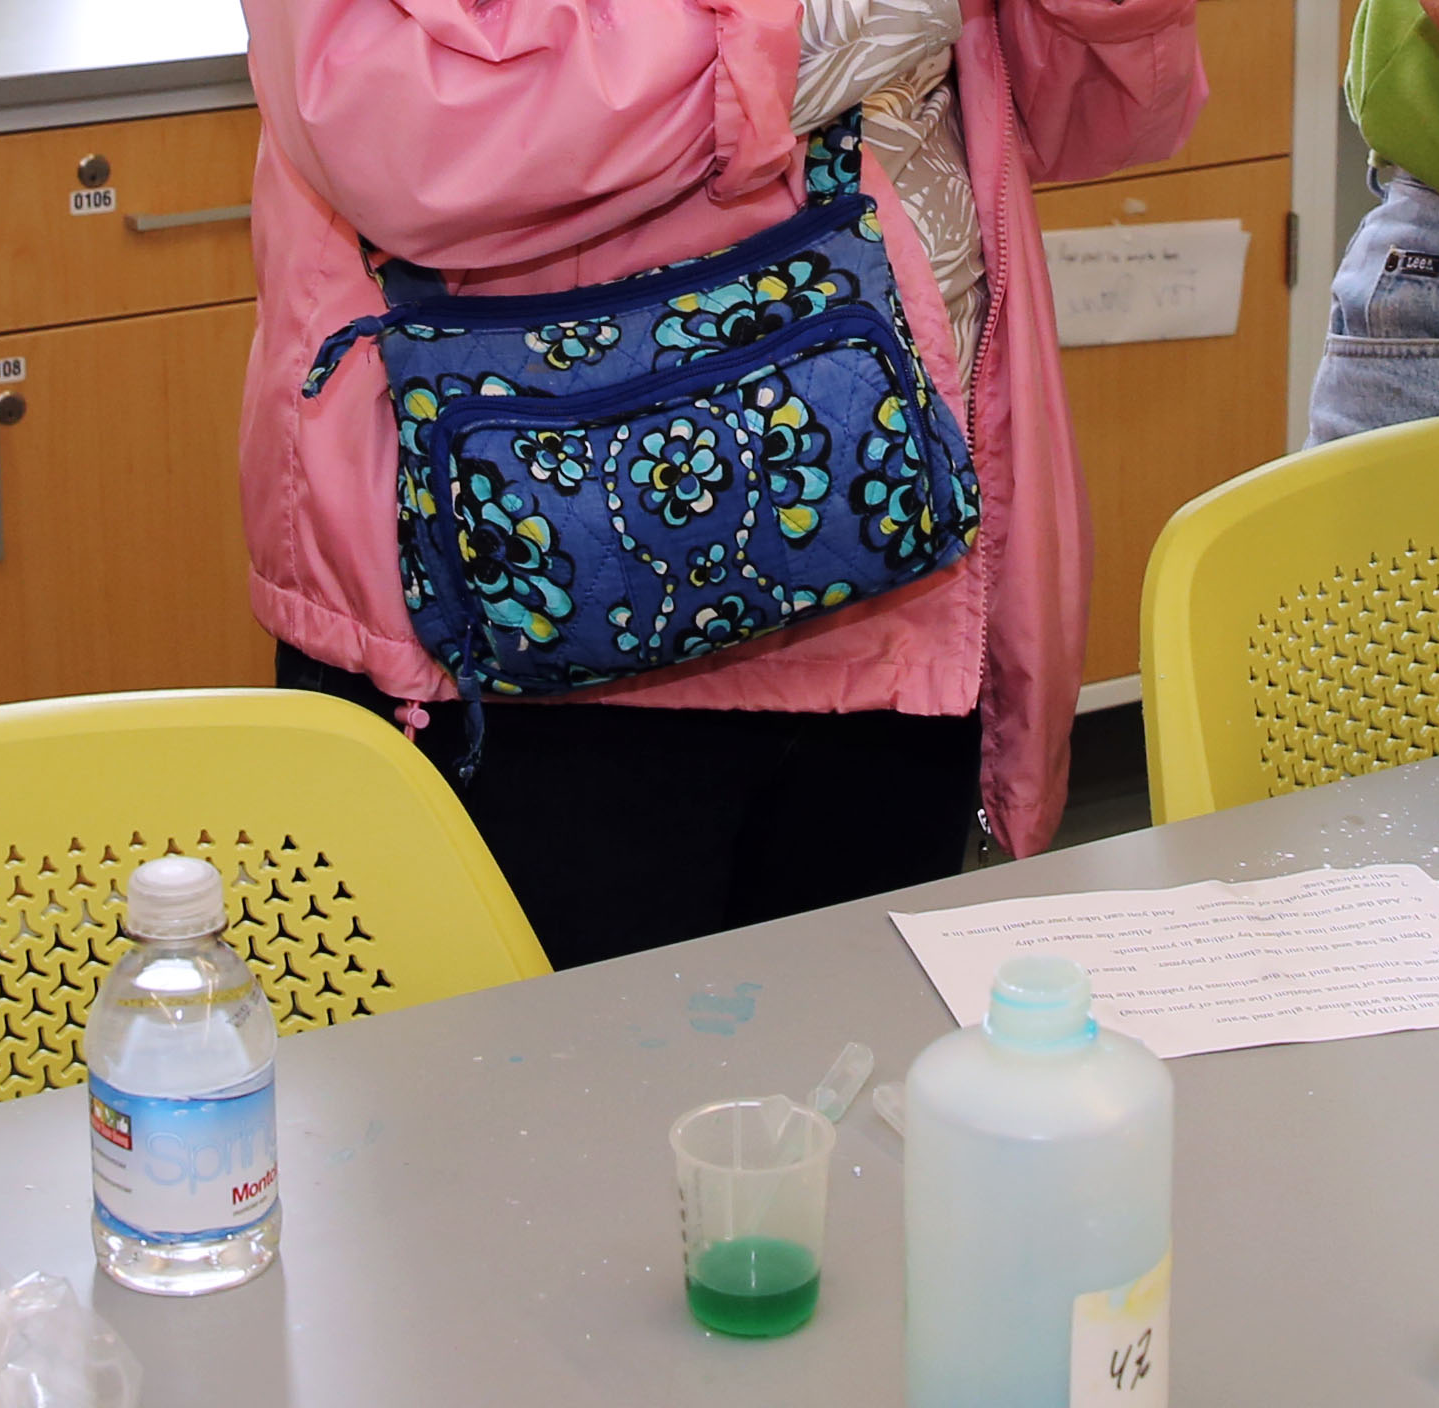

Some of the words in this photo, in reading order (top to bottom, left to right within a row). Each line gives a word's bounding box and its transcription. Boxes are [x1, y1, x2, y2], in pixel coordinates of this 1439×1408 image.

[73, 191, 112, 211] 0106
[1048, 916, 1073, 924] your
[1003, 920, 1044, 930] eyeball
[1118, 929, 1153, 937] Allow
[1194, 934, 1234, 945] rolling
[1150, 943, 1177, 951] your
[1331, 942, 1353, 950] and
[1274, 988, 1322, 998] solution
[1169, 1003, 1195, 1012] your
[1252, 1012, 1275, 1021] and
